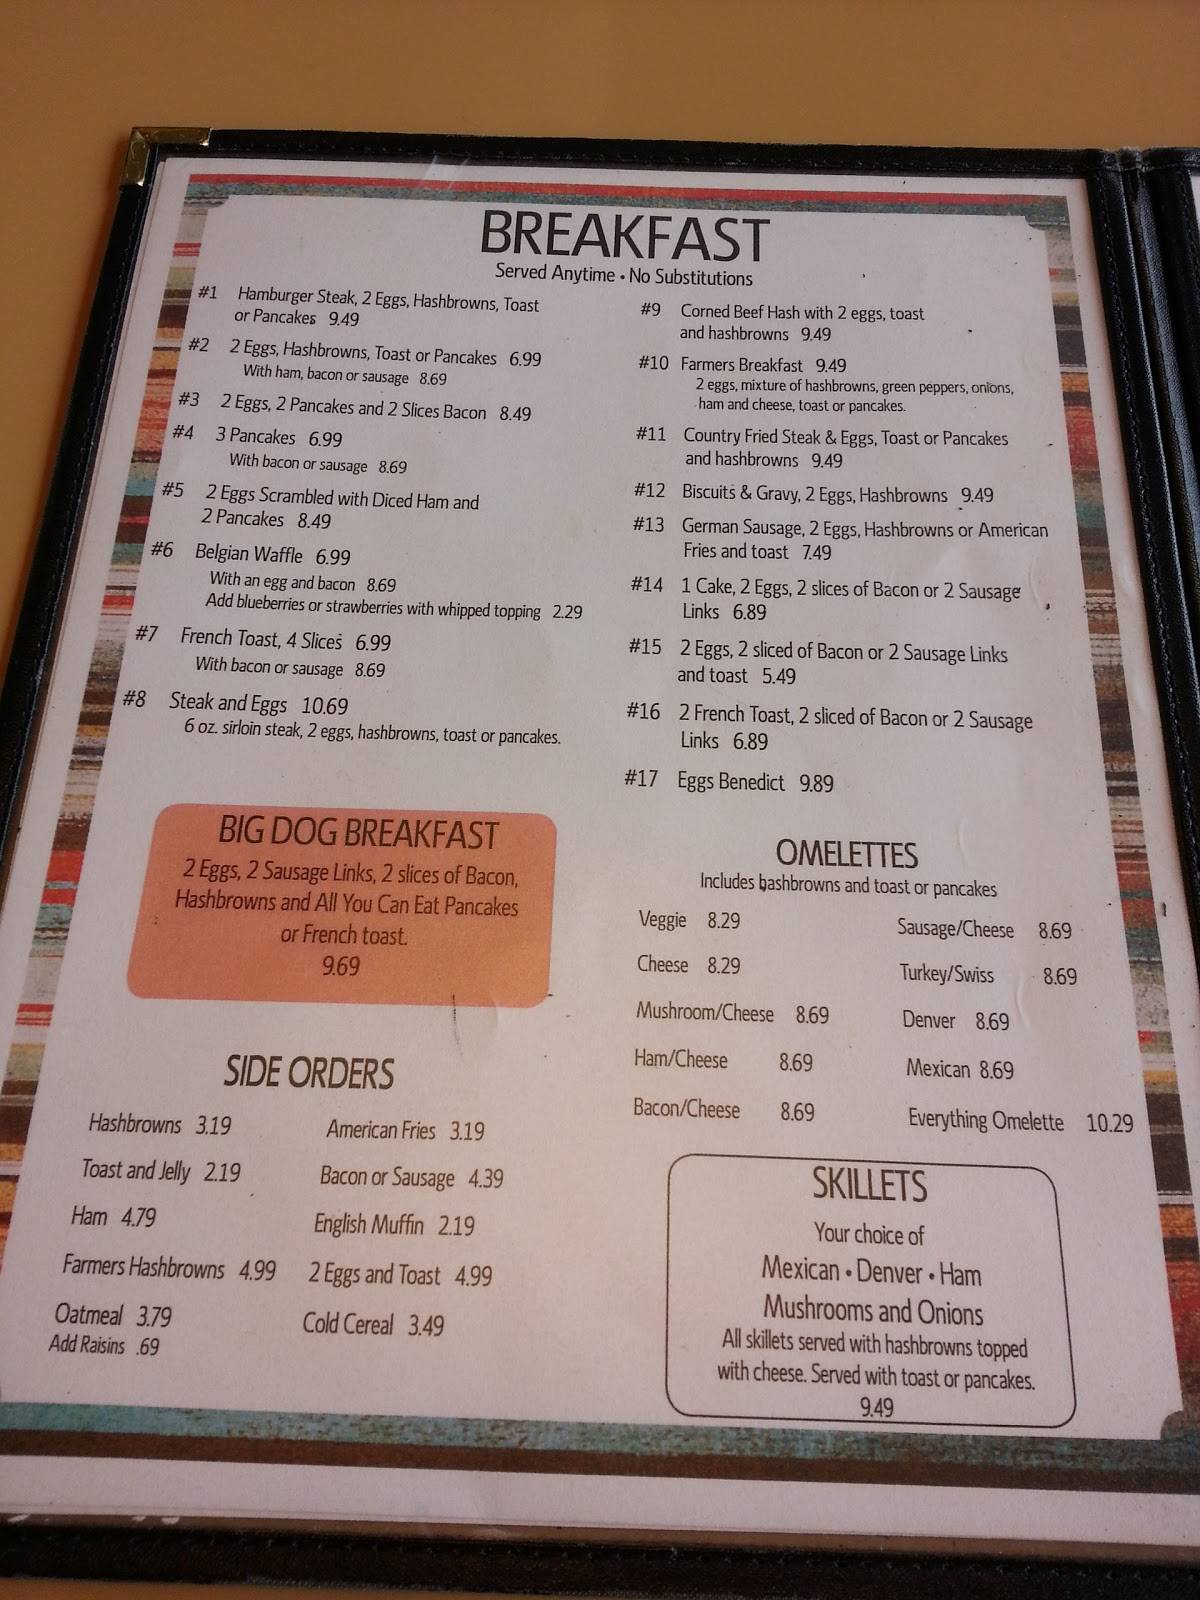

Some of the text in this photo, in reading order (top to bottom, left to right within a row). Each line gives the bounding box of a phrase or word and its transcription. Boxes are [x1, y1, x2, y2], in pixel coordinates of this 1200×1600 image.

[480, 209, 771, 262] BREAKFAST
[494, 261, 754, 287] Served Anytime No Substitutions
[197, 285, 540, 313] #1 Hamburger Steak, 2 Eggs, Hashbrowns, Toast
[234, 307, 360, 328] or Pancakes 9.49
[640, 301, 926, 324] #9 Corned Beef Hash with 2 eggs, toast
[679, 324, 832, 342] and hashbrowns 9.49
[243, 363, 448, 387] With ham, bacon or sausage 8.69
[638, 354, 847, 374] #10 Farmers Breakfast 9.49
[695, 376, 1015, 397] 2 eggs, mixture of hashbrowns, green peppers, onions,
[698, 395, 907, 415] ham and cheese, toast or pancakes.
[172, 424, 343, 448] #4 3 Pancakes 6.99
[633, 482, 995, 506] #12 Biscuits & Gravy, 2 Eggs, Hashbrowns 9.49
[150, 540, 352, 567] #6 Belgian Waffle 6.99
[683, 541, 832, 561] Fries and toast 7.49
[204, 592, 583, 622] Add blueberries or strawberries with whipped topping 2.29
[135, 624, 392, 652] #7 French Toast, 4 Slices 6.99
[623, 768, 835, 794] #17 Eggs Benedict 9.89
[218, 814, 501, 850] BIG DOG BREAKFAST
[775, 838, 920, 870] OMELETTES
[700, 871, 756, 891] Includes
[844, 875, 871, 894] and
[873, 878, 911, 895] toast
[913, 882, 930, 896] or
[932, 879, 998, 900] pancakes
[638, 909, 741, 932] Veggie 8.29
[897, 916, 1073, 941] Sausage/Cheese 8.69
[280, 922, 408, 946] or French toast.
[322, 954, 361, 977] 9.69
[899, 962, 1078, 987] Turkey/Swiss 8.69
[635, 1000, 830, 1025] Mushroom/Cheese 8.69
[223, 1053, 395, 1091] SIDE ORDERS
[88, 1111, 233, 1136] Hashbrowns 3.19
[325, 1118, 486, 1142] American Fries 3.19
[908, 1106, 1134, 1134] Everything Omelette 10.29
[82, 1157, 242, 1186] Toast and Jelly 2.19
[812, 1165, 928, 1203] SKILLETS
[314, 1211, 476, 1239] English Muffin 2.19
[62, 1252, 277, 1282] Farmers Hashbrowns 4.99
[761, 1253, 983, 1287] Mexican Denver Ham
[54, 1301, 173, 1329] Oatmeal 3.79
[763, 1293, 984, 1327] Mushrooms and Onions
[47, 1333, 161, 1357] Add Raisins .69
[717, 1359, 1036, 1394] with cheese. Served with toast or pancakes.
[859, 1395, 895, 1419] 9.49
